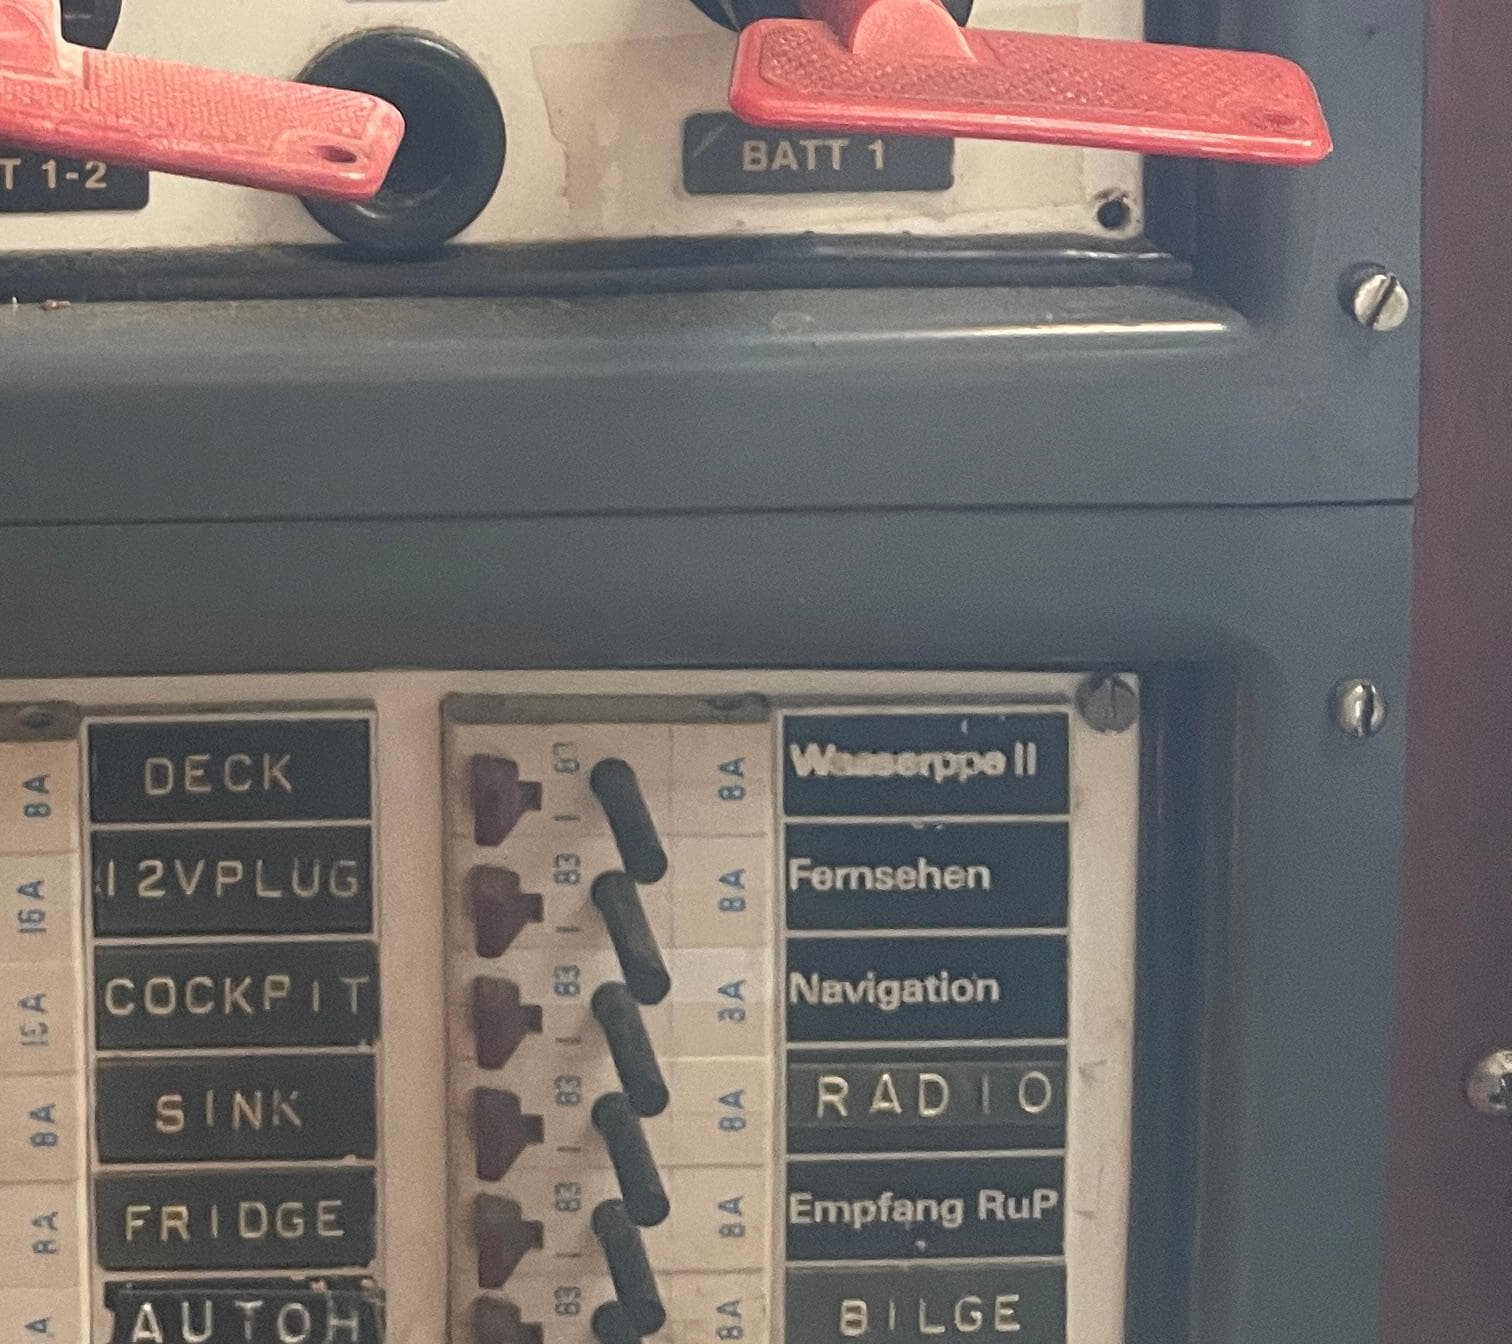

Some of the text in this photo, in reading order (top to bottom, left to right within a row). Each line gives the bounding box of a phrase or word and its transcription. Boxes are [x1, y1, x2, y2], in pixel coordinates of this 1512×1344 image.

[39, 158, 109, 194] 1-2
[741, 138, 885, 173] BATT 1
[143, 753, 294, 797] DECK
[552, 851, 582, 885] 83
[789, 856, 991, 892] Fernsehen
[103, 973, 372, 1016] COCKPIT
[789, 972, 1001, 1011] Navigation
[154, 1090, 303, 1135] SINK
[817, 1071, 1054, 1119] RADIO
[124, 1199, 346, 1243] FRIDGE
[789, 1189, 1059, 1229] Empfang RuP
[839, 1293, 1023, 1338] BILGE
